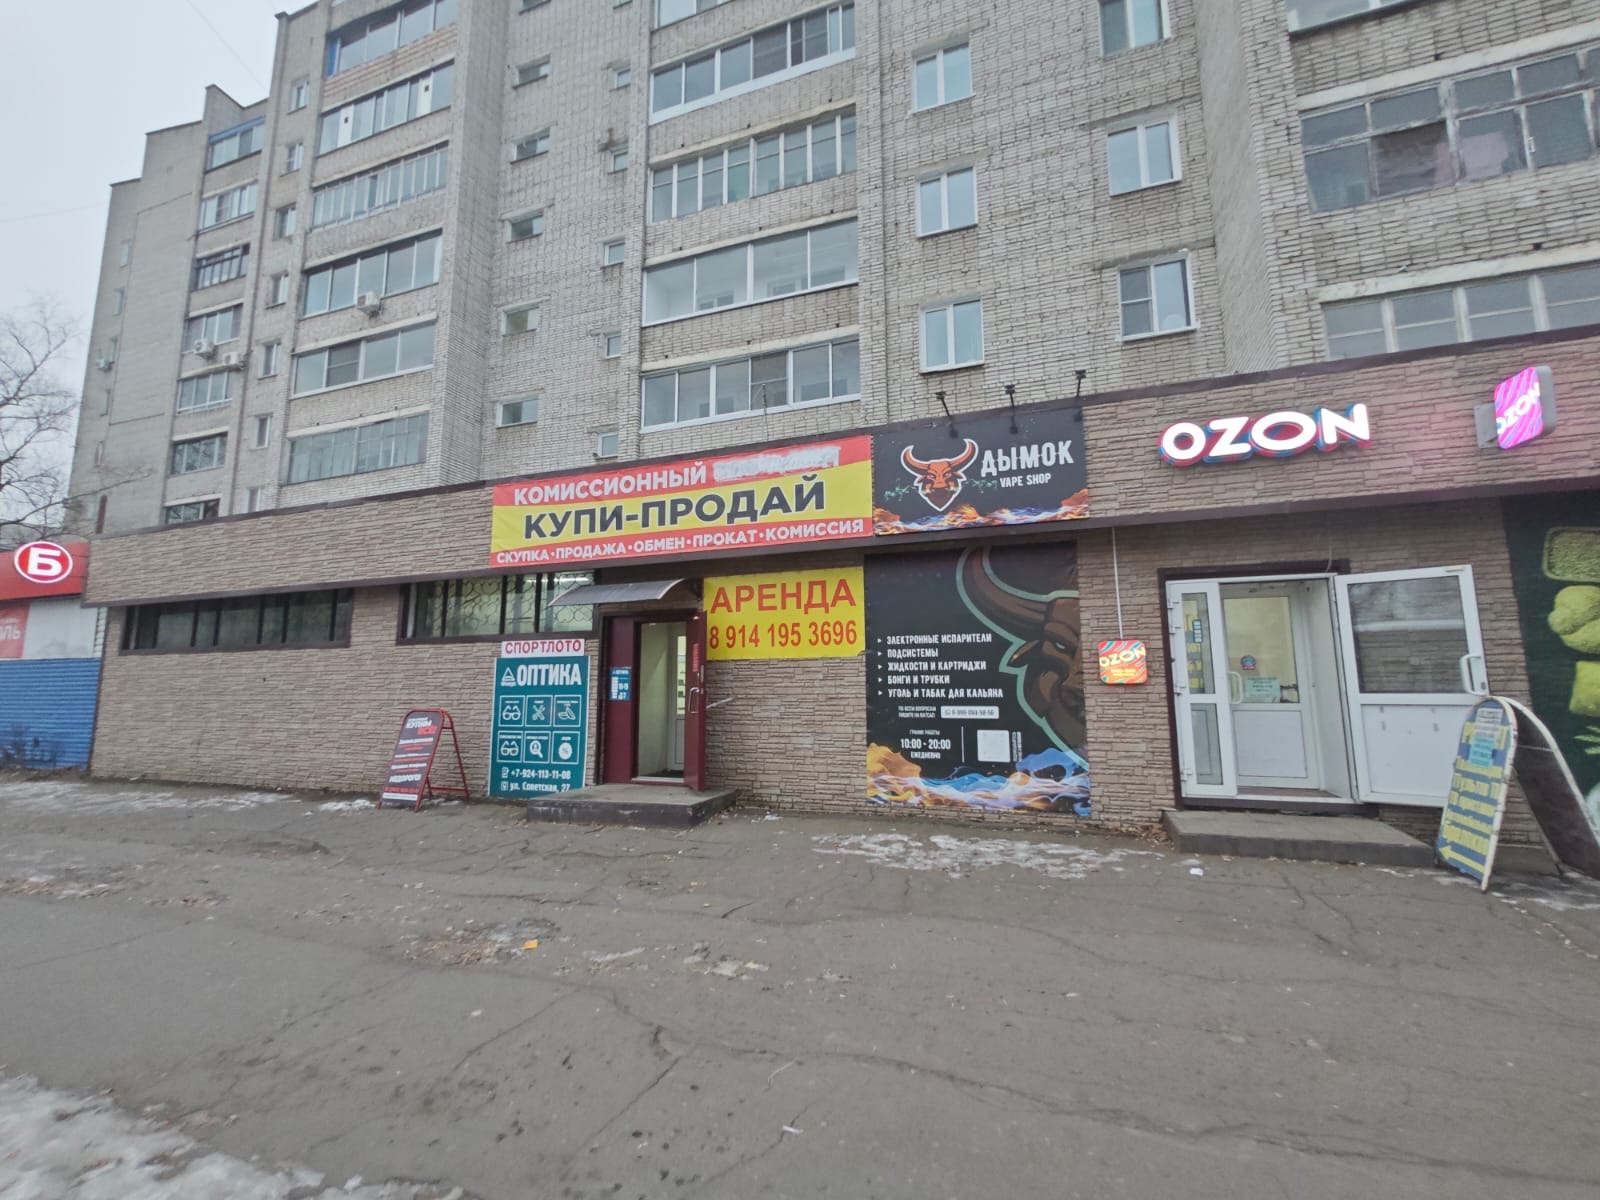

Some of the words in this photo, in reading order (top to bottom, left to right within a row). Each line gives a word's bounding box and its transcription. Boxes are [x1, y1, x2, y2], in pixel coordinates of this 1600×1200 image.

[1158, 403, 1372, 466] OZON
[980, 440, 1074, 477] ДЫМОК
[514, 462, 706, 505] КОМИССИОННЫЙ
[1000, 475, 1023, 488] VAPE
[1026, 472, 1051, 485] SHOP
[524, 474, 825, 539] КУПИ-ПРОДАЙ
[496, 549, 549, 565] СКУПКА
[556, 542, 626, 560] ПРОДАЖА
[634, 536, 685, 552] ОБМЕН
[693, 529, 756, 547] ПРОКАТ
[766, 519, 864, 541] КОМИССИЯ
[27, 546, 63, 577] Б
[710, 578, 856, 614] АРЕНДА
[709, 625, 720, 649] 8
[726, 624, 760, 649] 914
[768, 622, 801, 647] 195
[808, 620, 857, 646] 3696
[886, 634, 939, 645] ЭЛЕКТРОННЫЕ
[941, 633, 992, 644] ИСПАРИТЕЛИ
[505, 639, 581, 654] СПОРТЛОТО
[887, 648, 938, 659] ПОДСИСТЕМЫ
[1099, 647, 1146, 667] OZON
[517, 664, 582, 686] ОПТИКА
[887, 661, 928, 672] ЖИДКОСТИ
[930, 661, 936, 671] И
[937, 661, 987, 672] КАРТРИДЖИ
[887, 675, 911, 685] БОНГИ
[913, 674, 919, 685] И
[920, 674, 950, 685] ТРУБКИ
[888, 688, 911, 698] УГОЛЬ
[913, 688, 919, 698] И
[921, 688, 946, 698] ТАБАК
[948, 688, 965, 699] ДЛЯ
[966, 688, 1004, 698] КАЛЬЯНА
[900, 738, 922, 749] 10:00
[928, 739, 951, 750] 20:00
